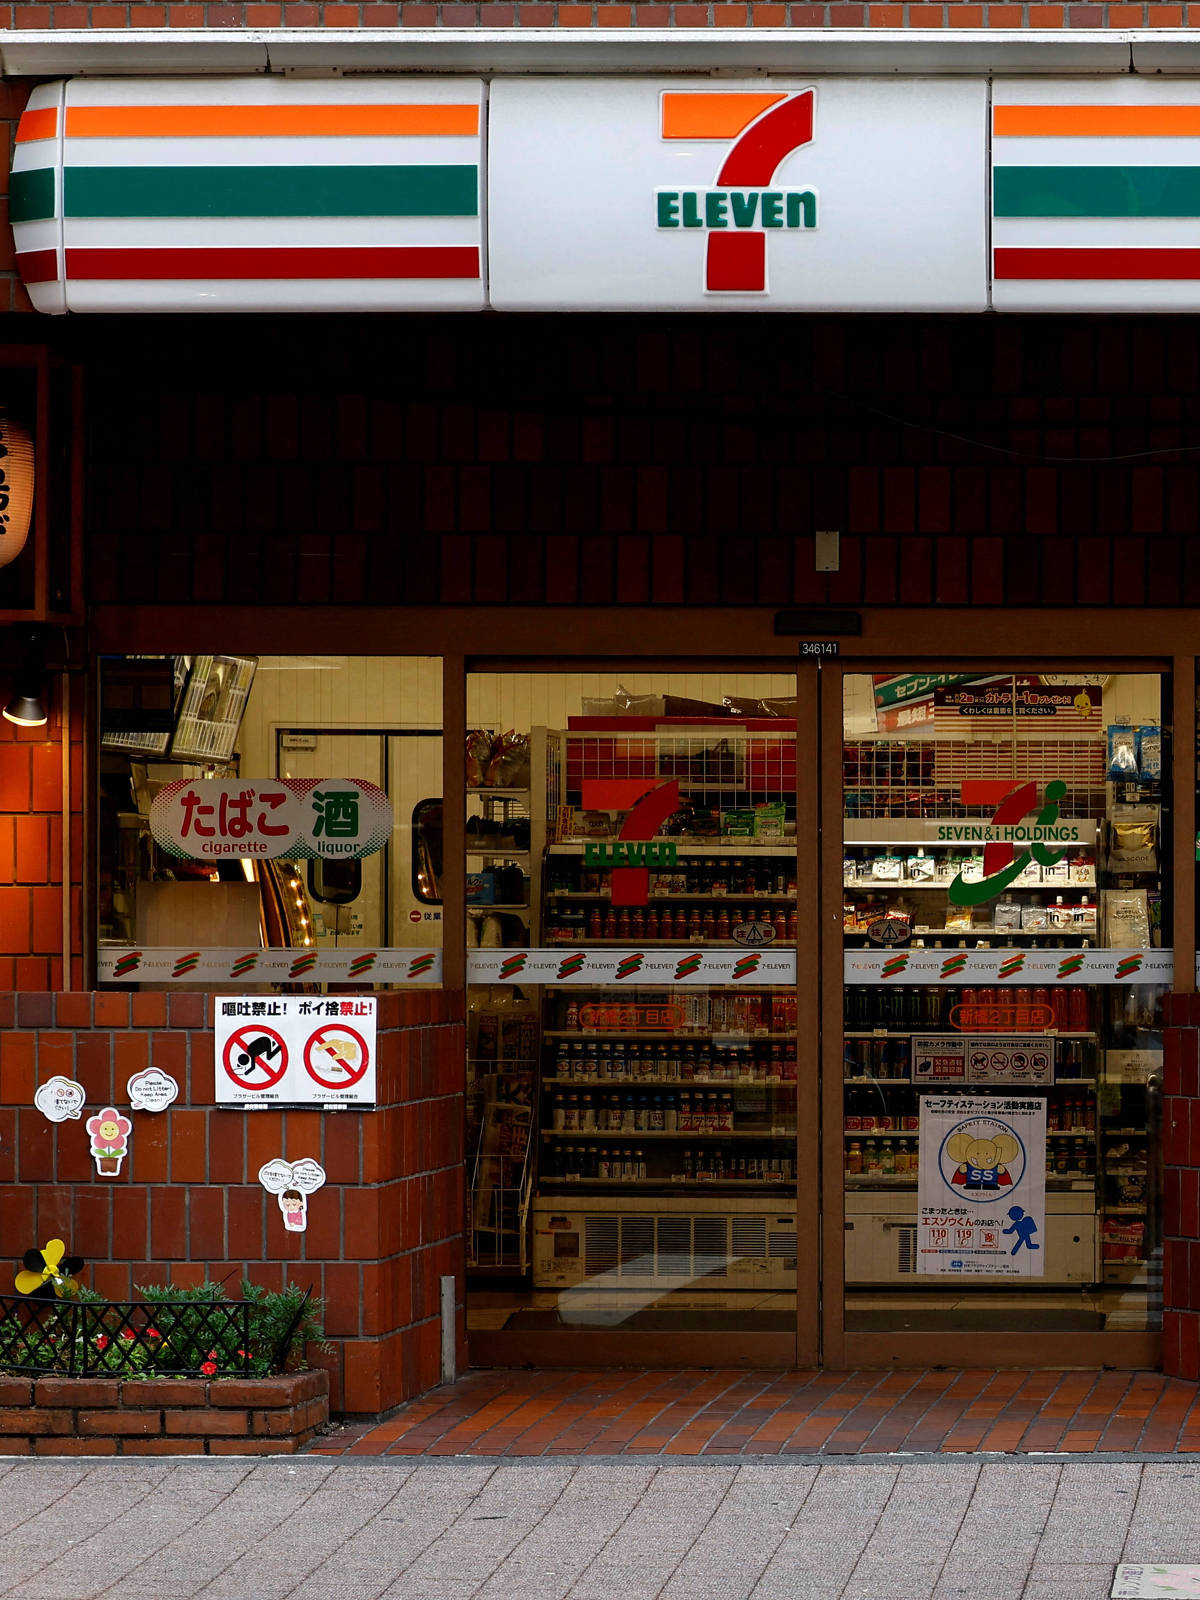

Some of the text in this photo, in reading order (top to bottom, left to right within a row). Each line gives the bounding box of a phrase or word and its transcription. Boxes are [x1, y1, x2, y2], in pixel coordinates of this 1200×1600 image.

[802, 643, 837, 654] 346141
[180, 788, 360, 838] たばこ 酒
[1004, 826, 1079, 841] HOLDINGS
[201, 840, 361, 855] cigarette liquor
[299, 1002, 373, 1016] ポイ捨禁止!
[931, 1229, 972, 1238] 110 119
